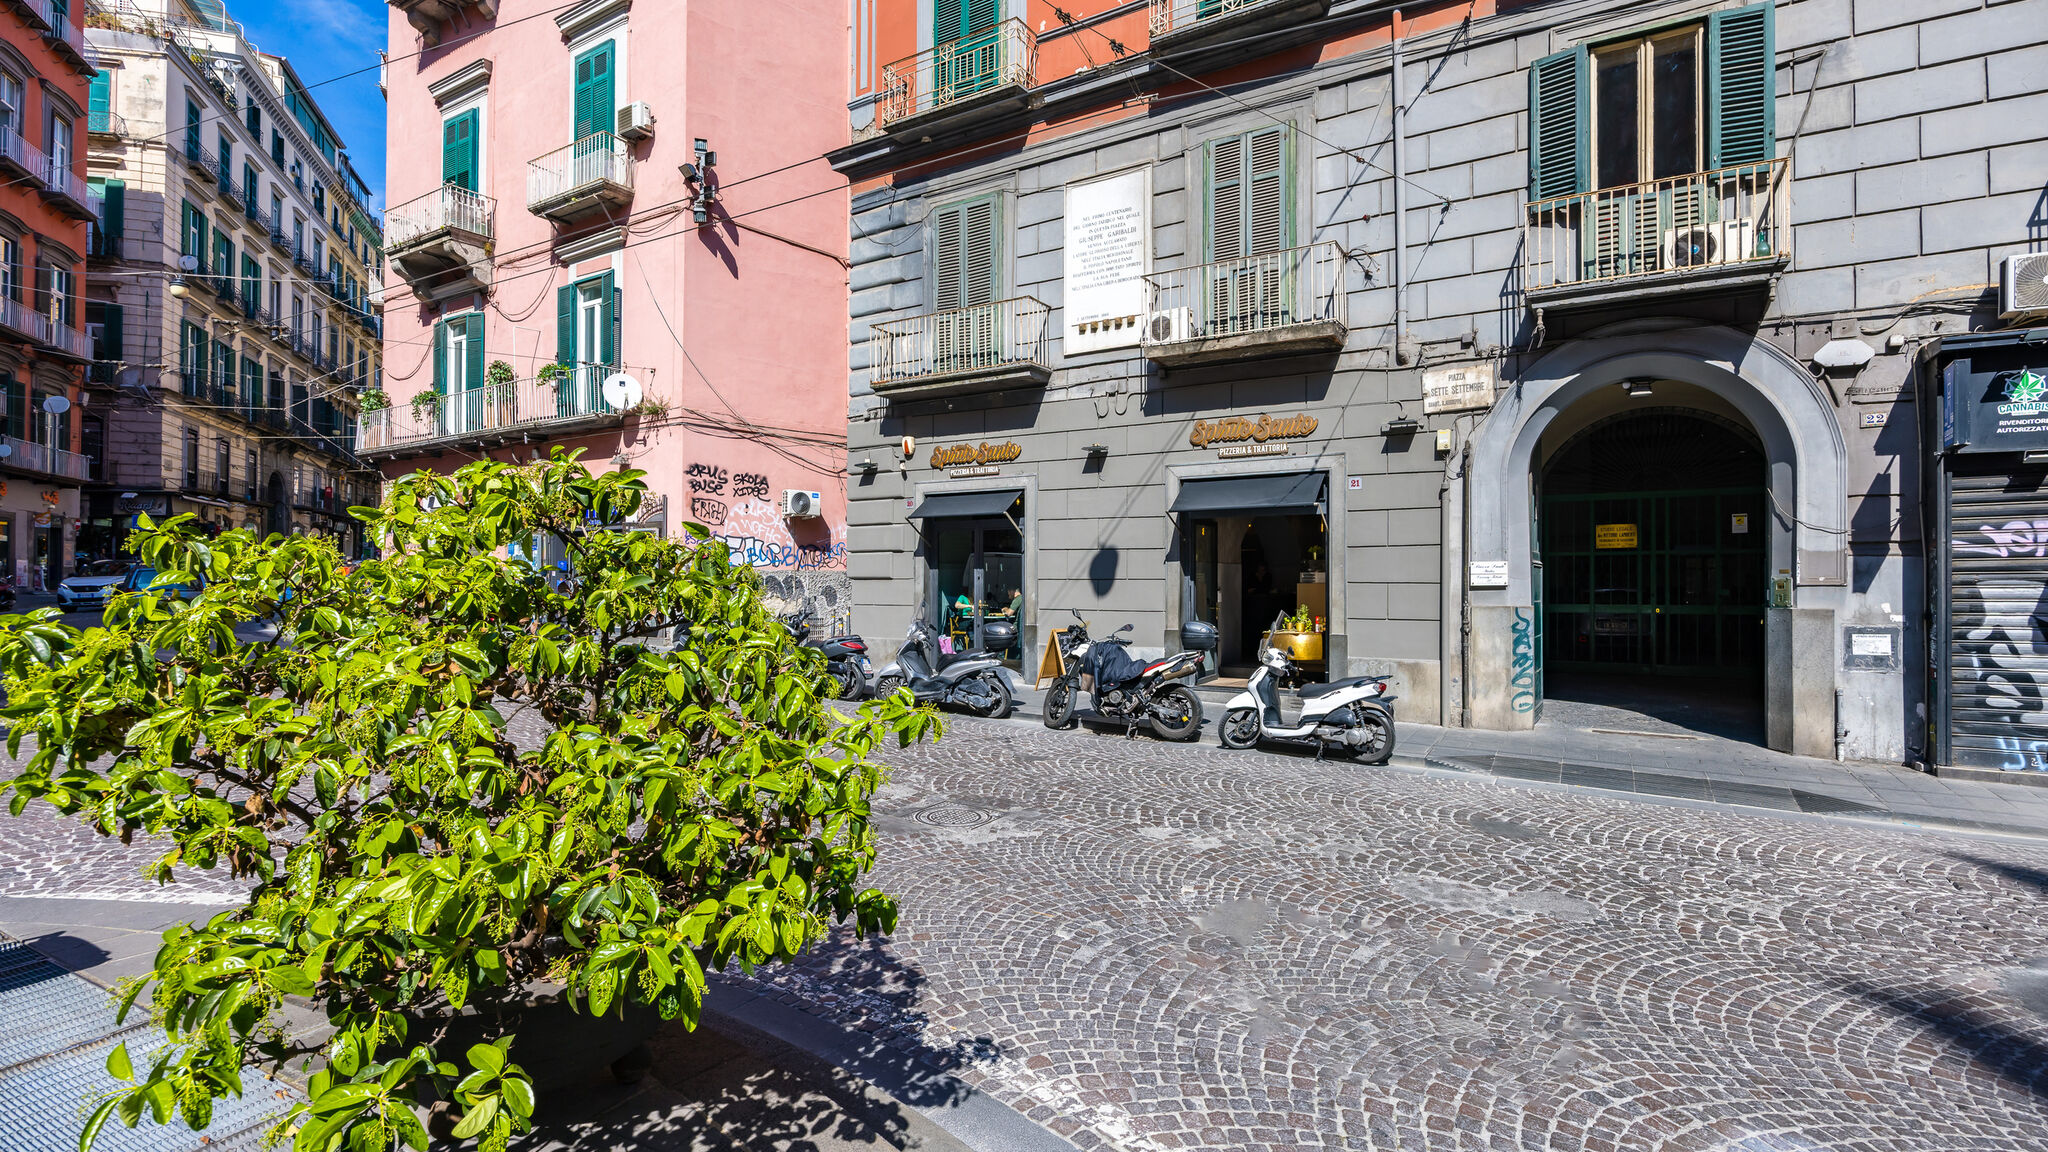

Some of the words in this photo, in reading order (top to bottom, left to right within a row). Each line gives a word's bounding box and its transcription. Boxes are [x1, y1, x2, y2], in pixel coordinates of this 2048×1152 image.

[1107, 226, 1137, 238] GARIBALDI
[1448, 372, 1466, 382] PIAZZA
[1431, 386, 1449, 397] SETTE
[1451, 382, 1485, 394] SETTEMBRE
[1866, 414, 1885, 424] 22
[1190, 416, 1257, 450] Spirito
[1252, 412, 1319, 443] Santo
[976, 440, 1022, 465] Santo
[1219, 446, 1246, 456] PIZZERIA
[1252, 443, 1288, 454] TRATTORIA
[950, 468, 969, 476] PIZZERIA
[974, 465, 999, 474] TRATTORIA
[1350, 480, 1360, 488] 21
